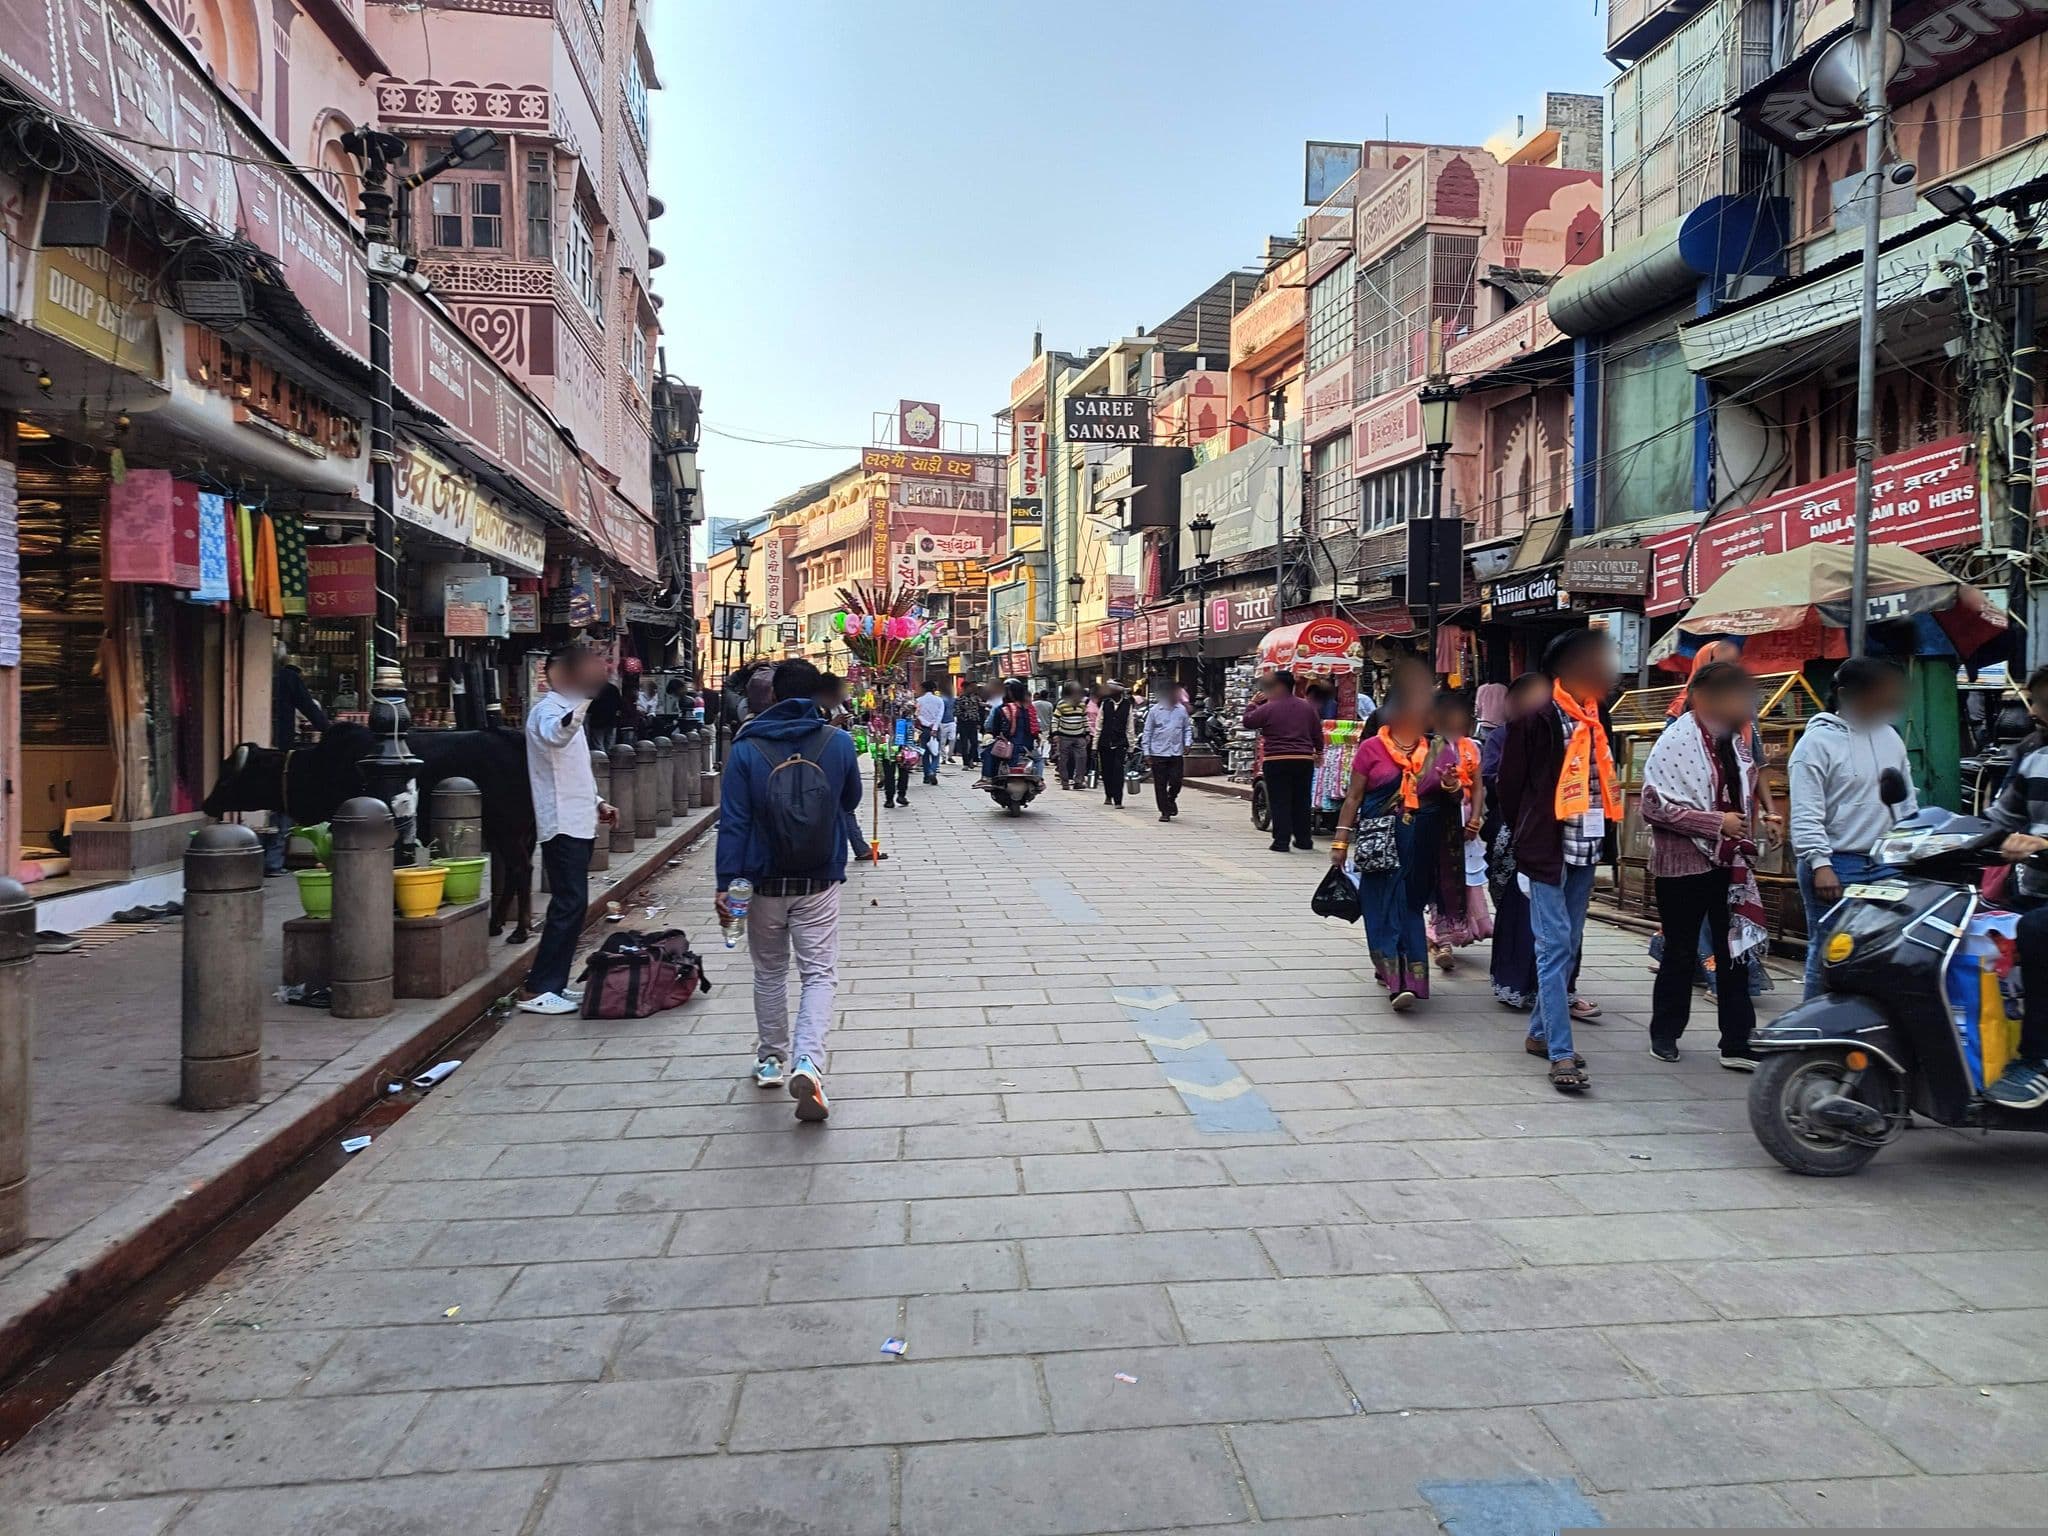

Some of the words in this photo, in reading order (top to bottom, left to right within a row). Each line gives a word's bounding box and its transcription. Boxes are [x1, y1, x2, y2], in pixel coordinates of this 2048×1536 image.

[48, 266, 94, 321] DILIP
[1075, 400, 1134, 417] SAREE
[1068, 423, 1141, 440] SANSAR
